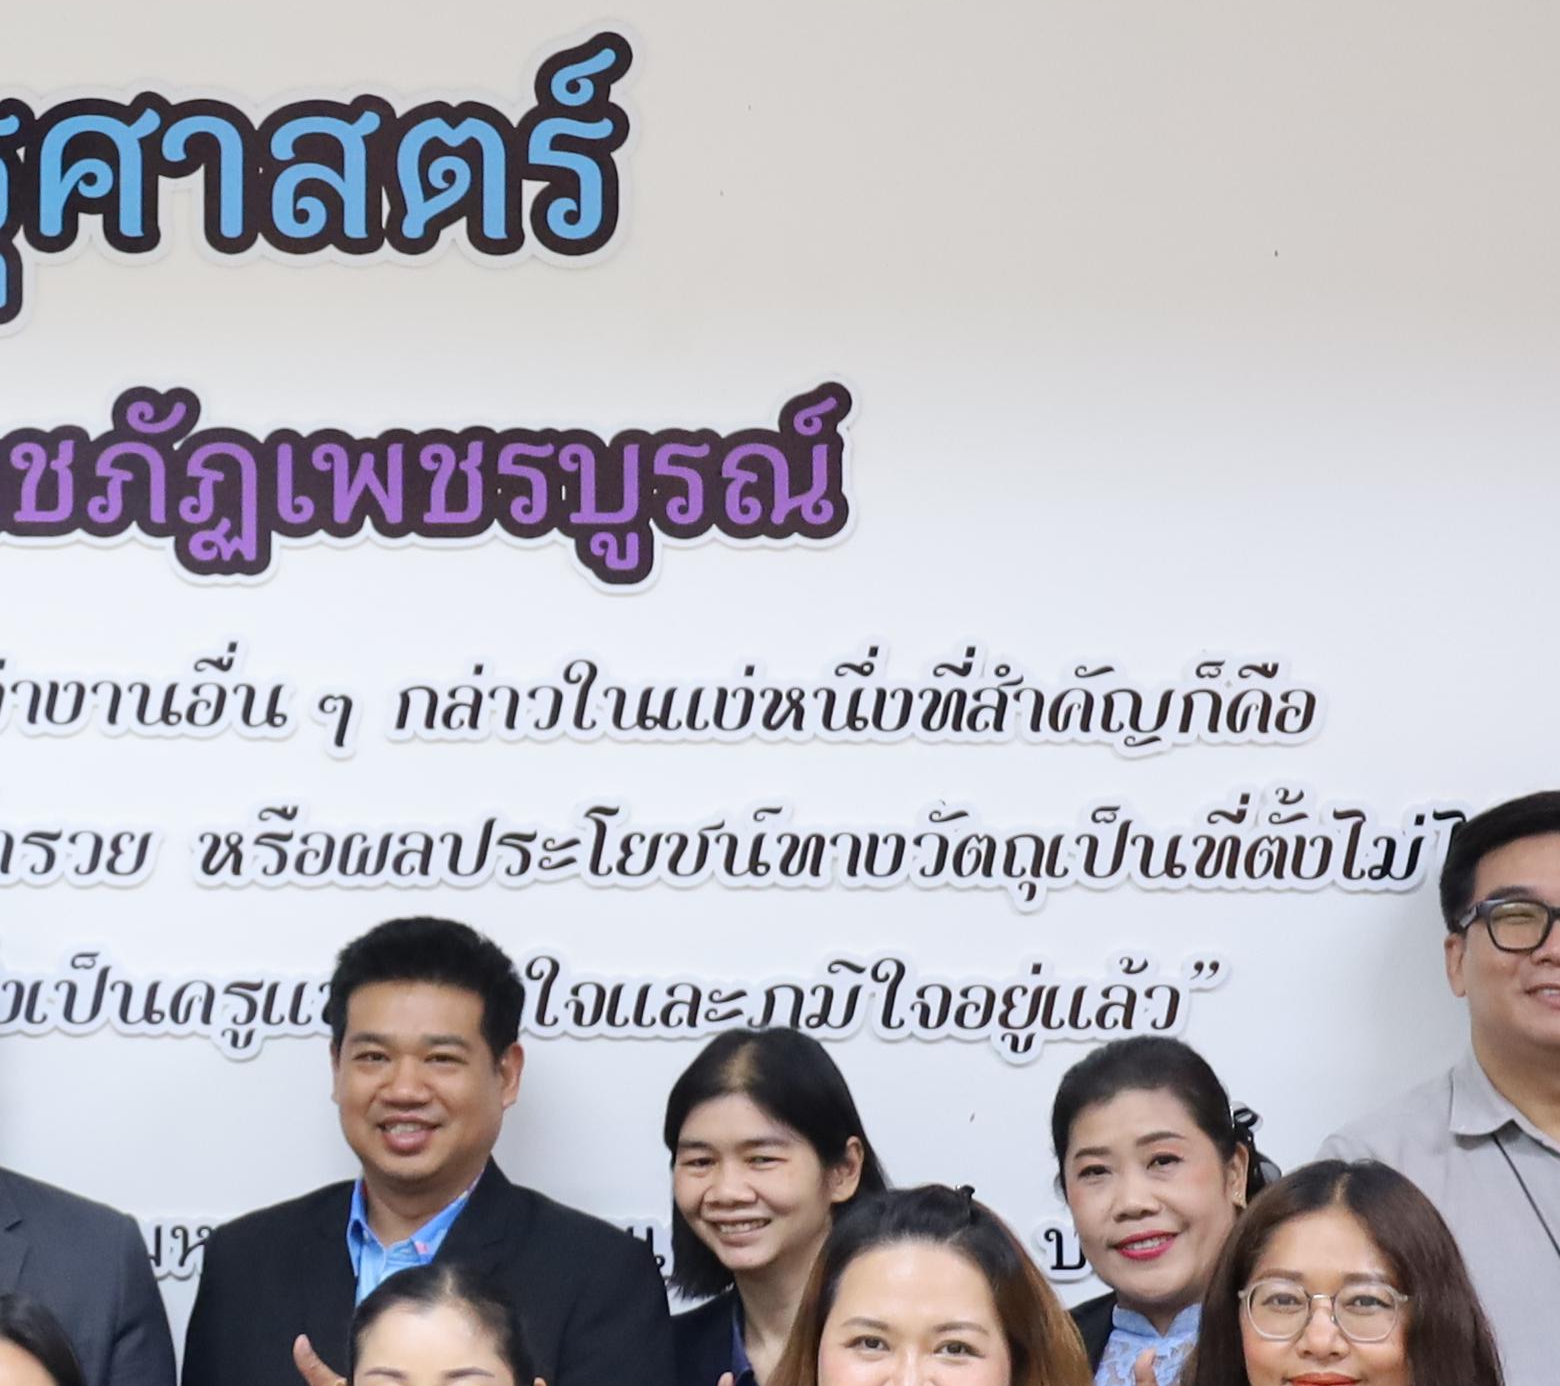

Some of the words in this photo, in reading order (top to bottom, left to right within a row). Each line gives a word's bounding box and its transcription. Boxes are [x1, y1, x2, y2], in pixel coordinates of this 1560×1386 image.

[395, 646, 1316, 747] กล่าวในแง่หนึ่งที่สำคัญก็คือ
